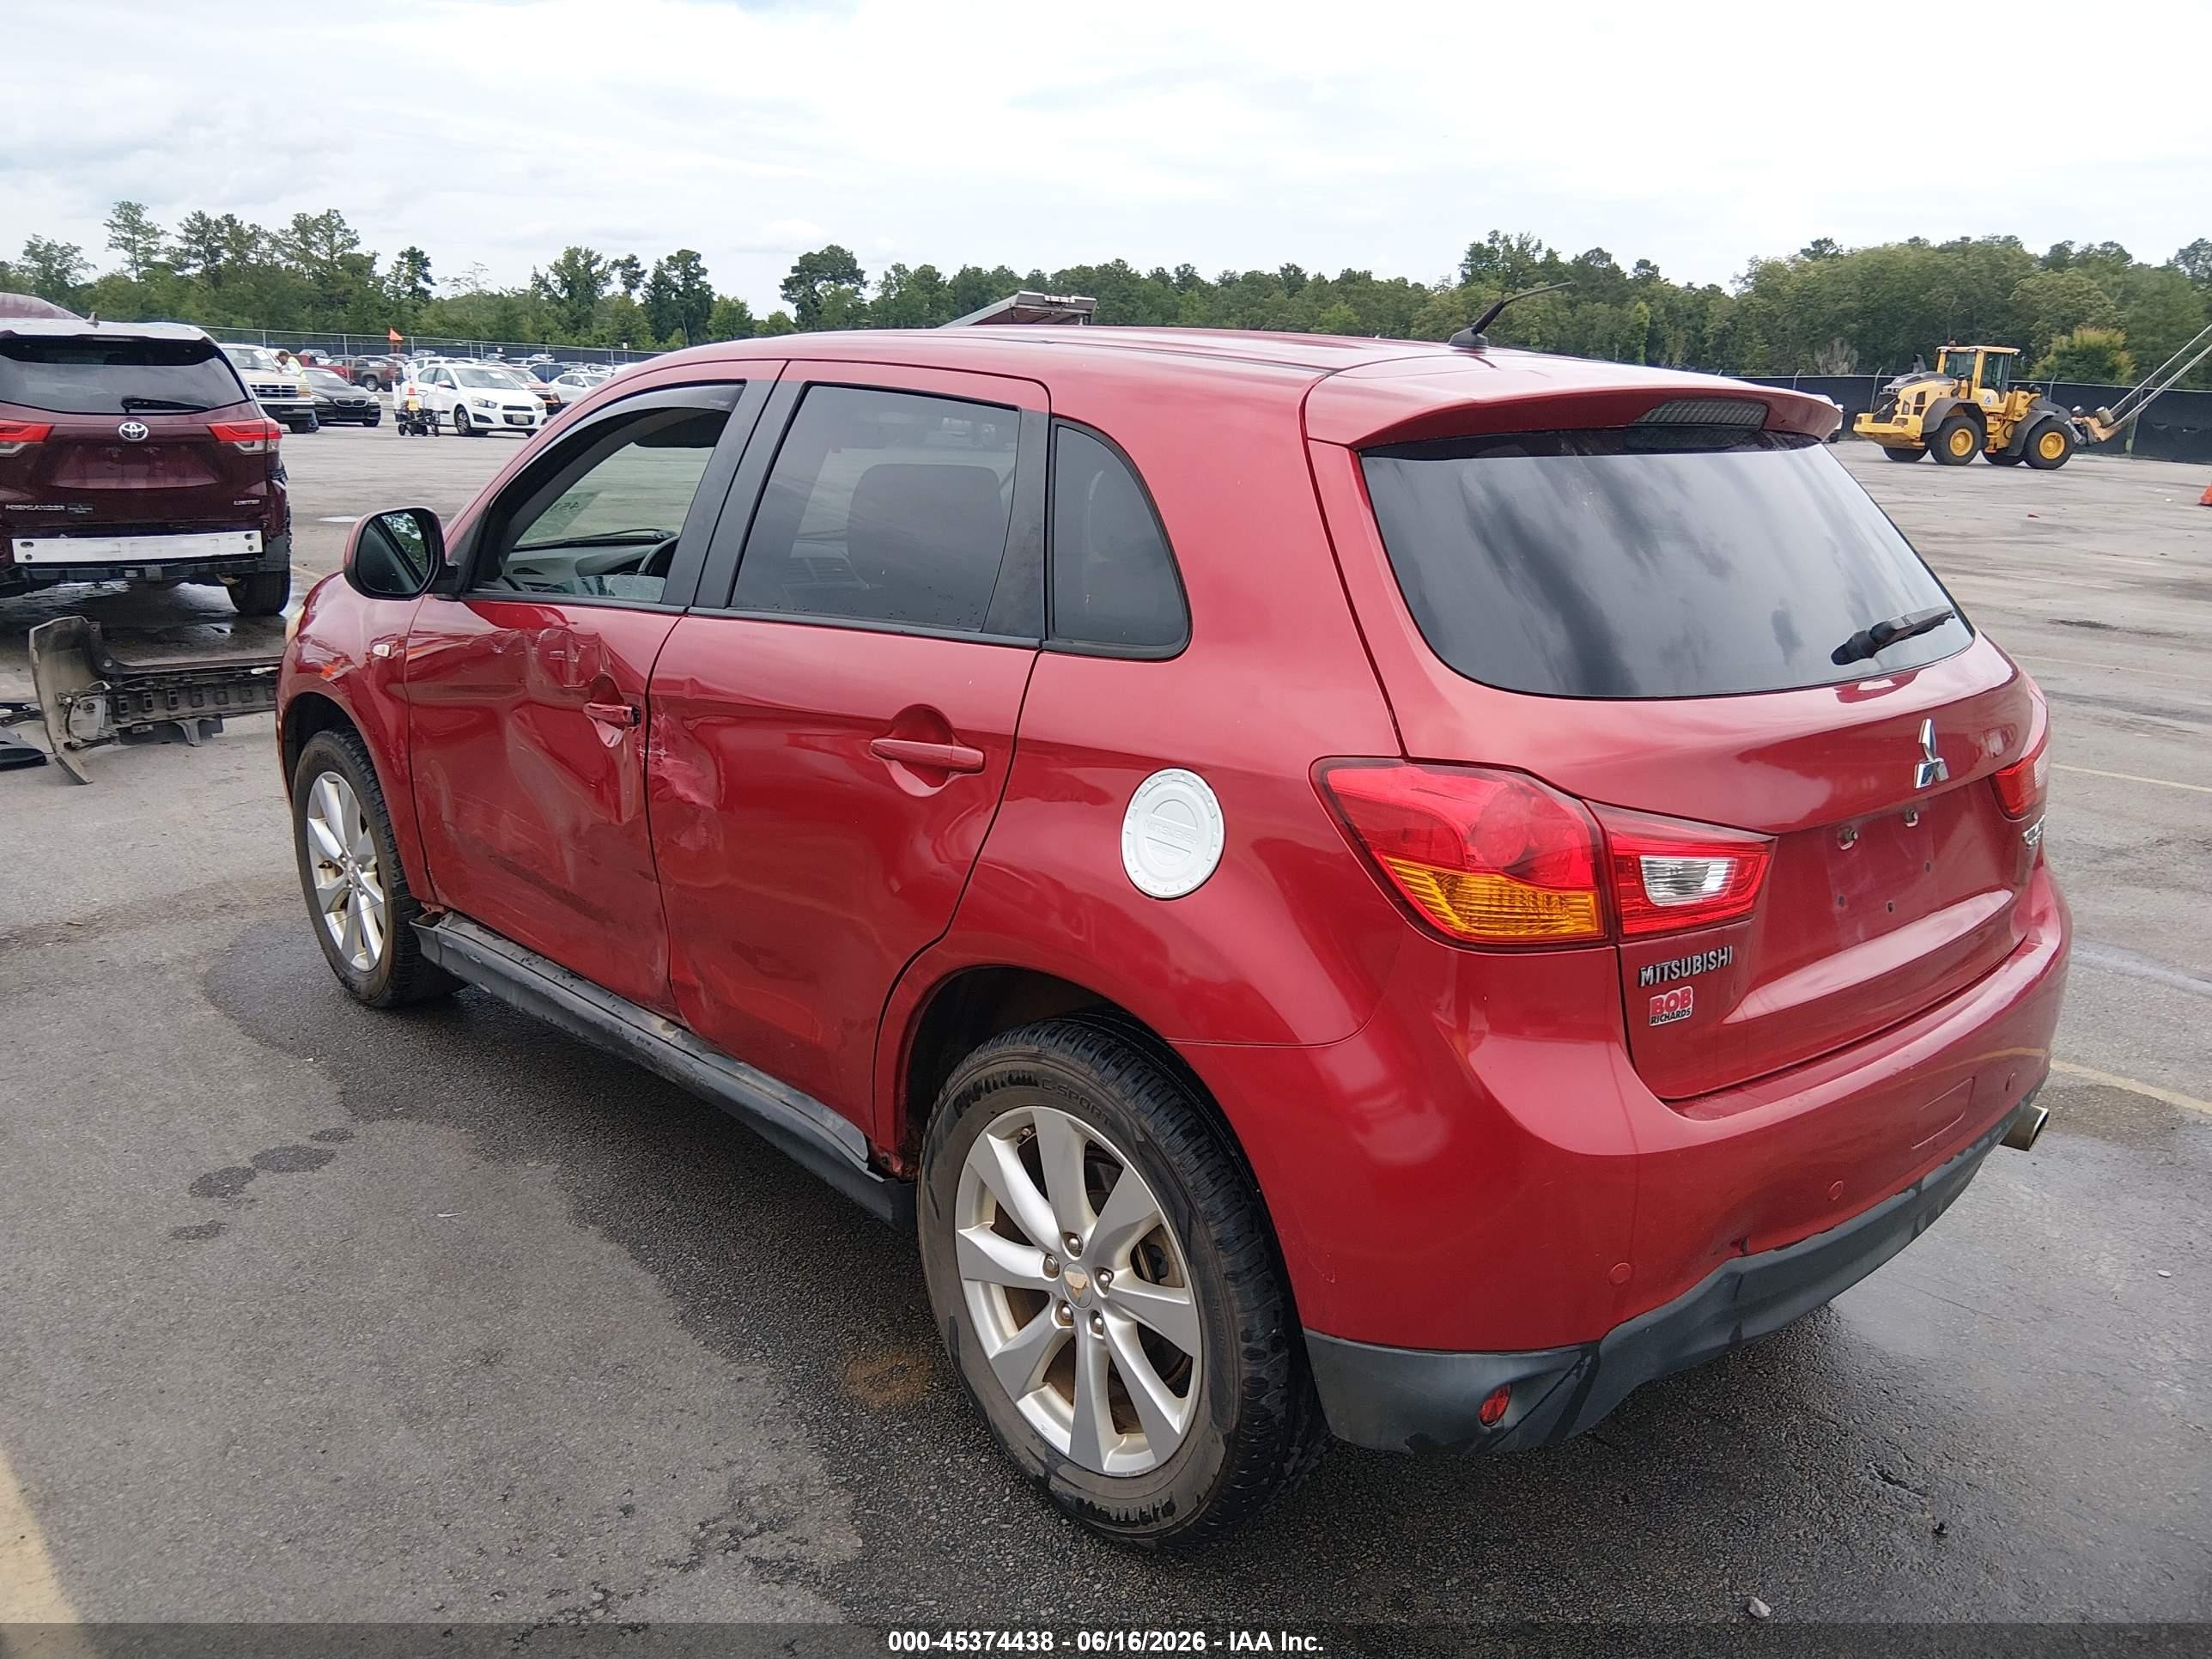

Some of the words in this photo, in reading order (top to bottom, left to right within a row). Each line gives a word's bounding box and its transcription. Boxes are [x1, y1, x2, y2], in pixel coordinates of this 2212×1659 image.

[1638, 945, 1733, 988] MITSUBISHI
[1650, 988, 1692, 1016] BOB
[1650, 1008, 1691, 1024] RICHARDS
